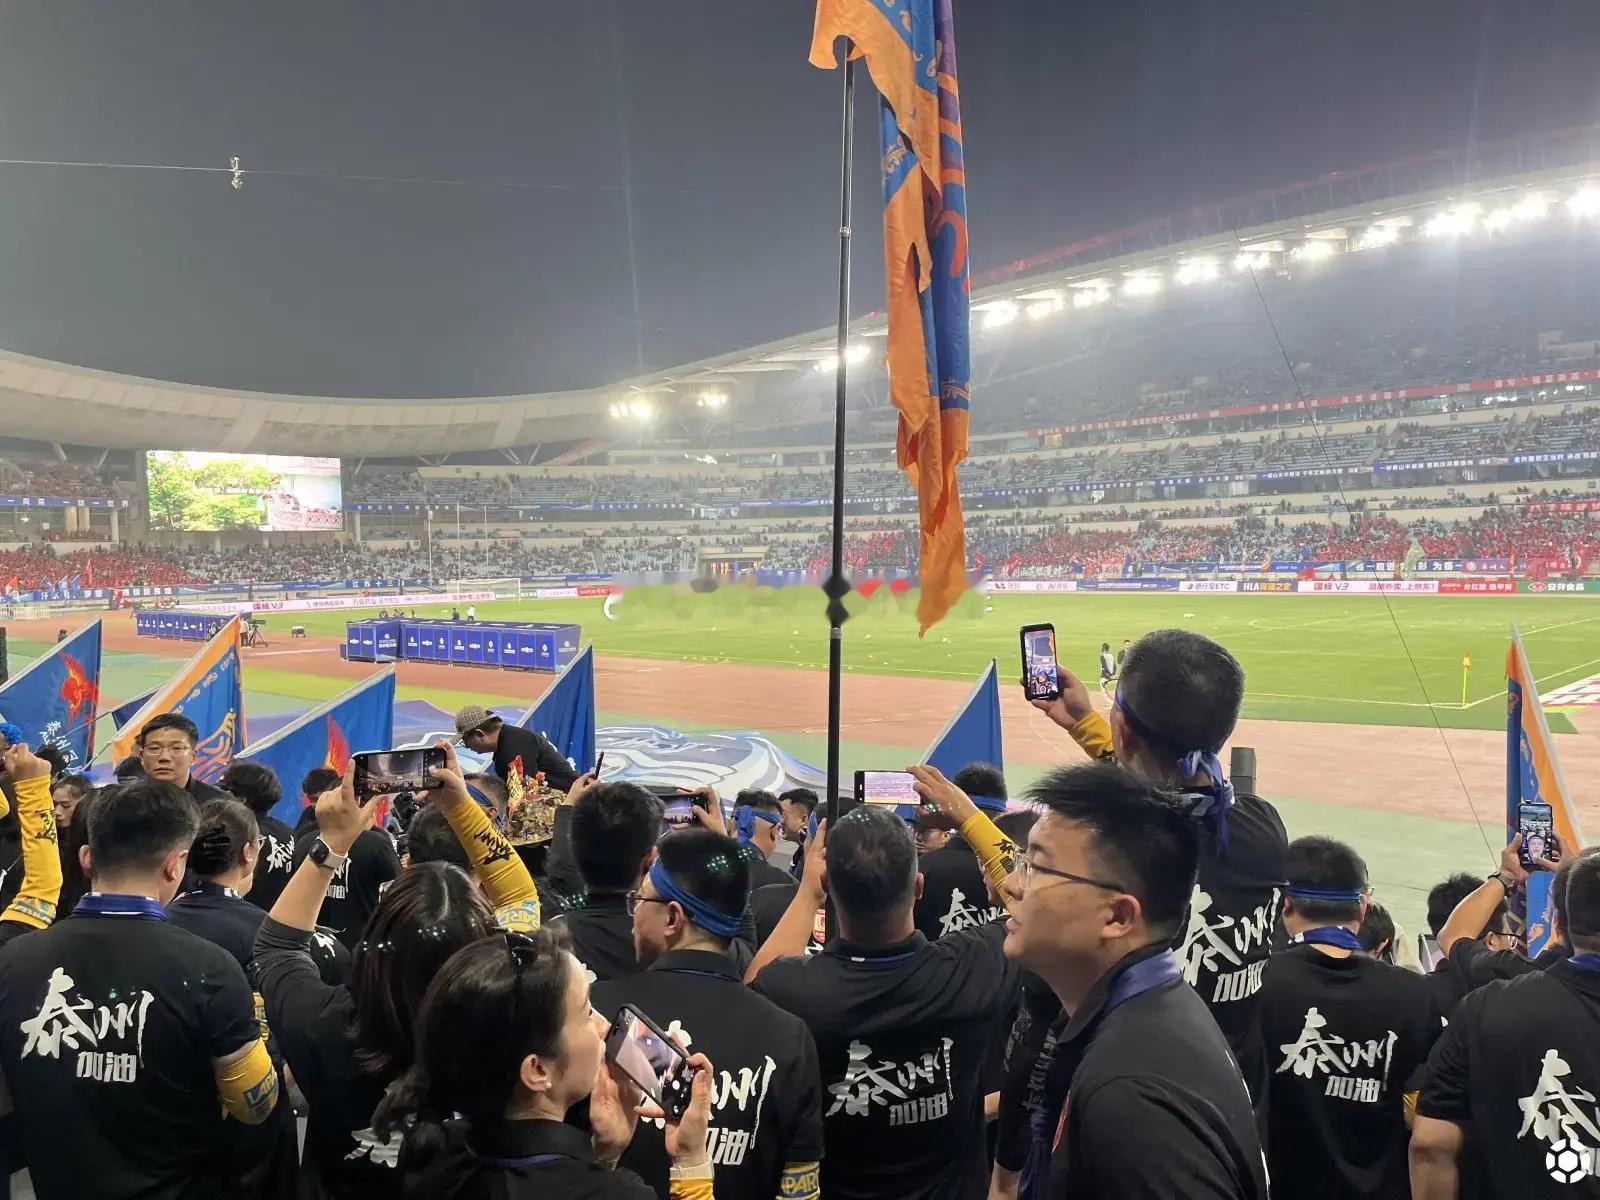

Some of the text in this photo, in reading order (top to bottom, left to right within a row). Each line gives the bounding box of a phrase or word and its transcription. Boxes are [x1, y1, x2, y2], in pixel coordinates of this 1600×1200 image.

[1172, 884, 1281, 987] 泰州
[20, 966, 155, 1069] 泰州
[1212, 958, 1269, 1003] 加油
[76, 1051, 138, 1083] 加油
[825, 1037, 955, 1118] 泰州
[1275, 1007, 1399, 1092] 泰州
[1324, 1075, 1381, 1104] 加油
[888, 1091, 949, 1127] 加油
[1516, 1048, 1600, 1145] 泰
